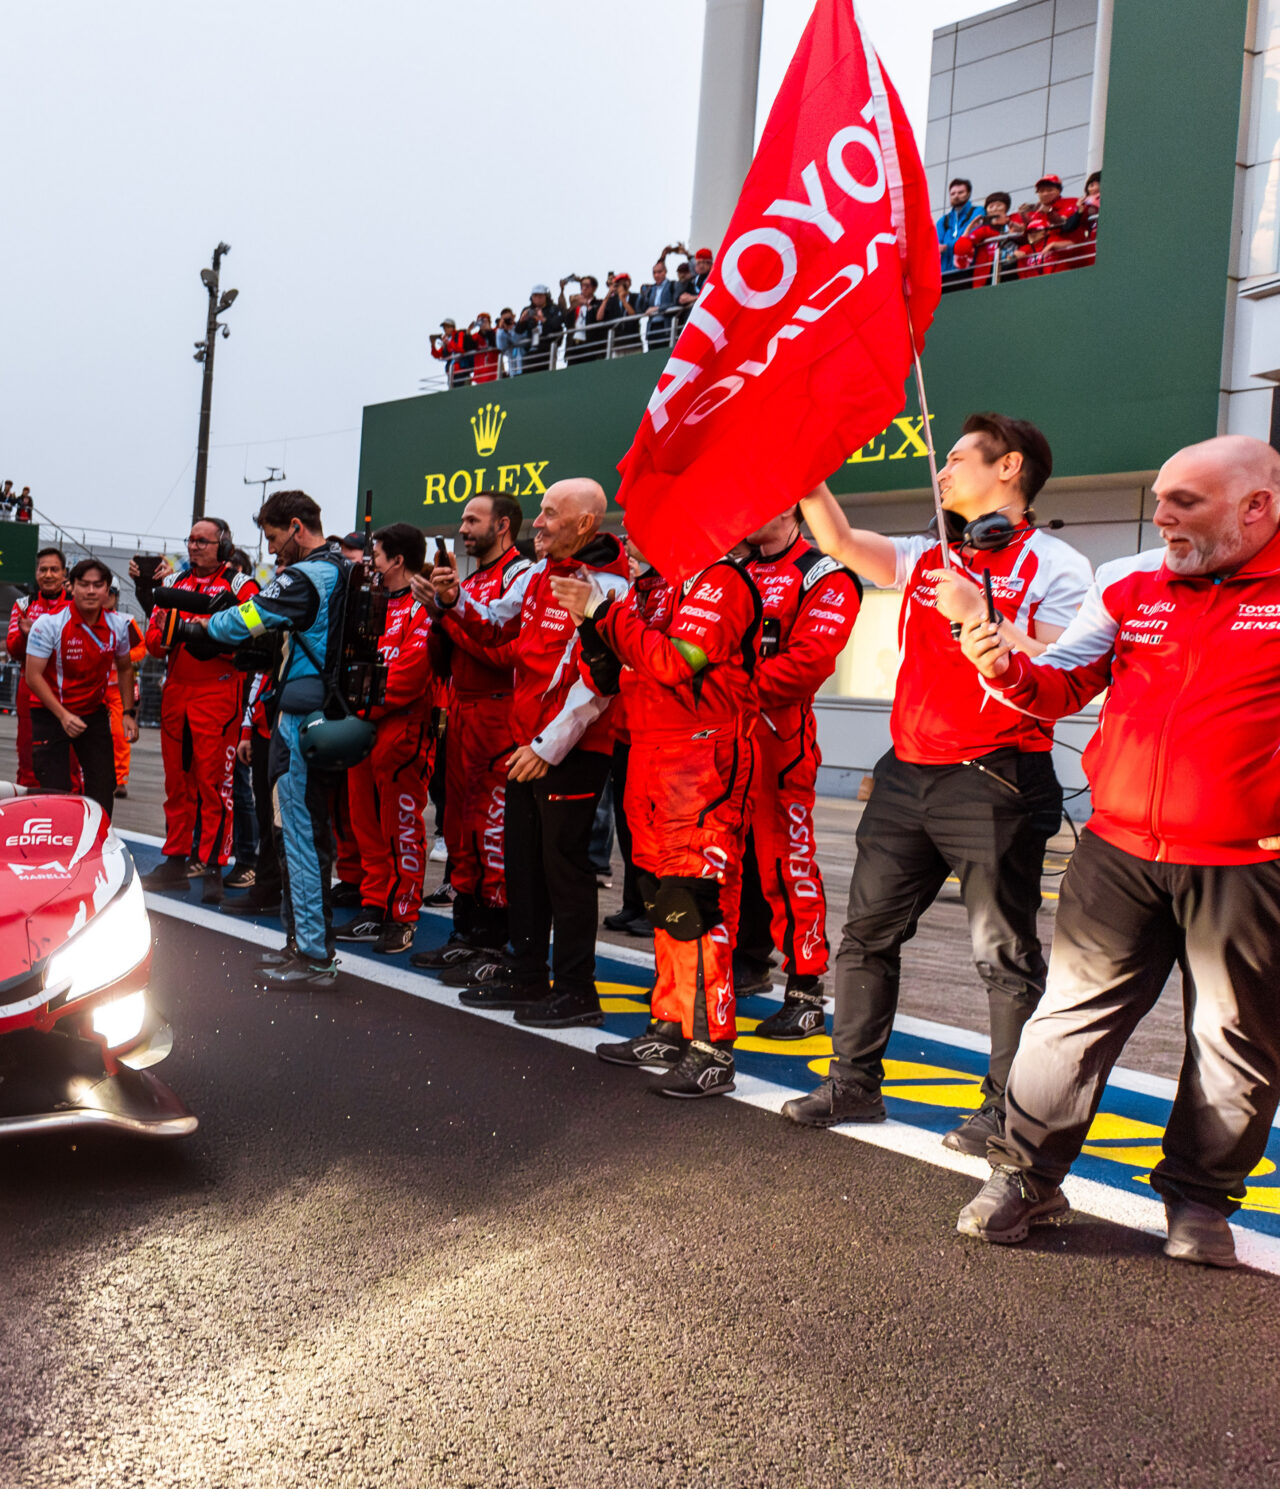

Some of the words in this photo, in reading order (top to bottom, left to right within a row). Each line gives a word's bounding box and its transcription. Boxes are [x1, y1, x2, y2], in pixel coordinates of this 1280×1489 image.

[1238, 604, 1280, 614] TOYOT
[541, 620, 565, 632] DENSO
[678, 622, 707, 637] JFE
[399, 793, 420, 873] DENSO
[5, 835, 74, 847] EDIFICE
[789, 803, 818, 898] DENSO
[18, 873, 72, 881] MARELLI
